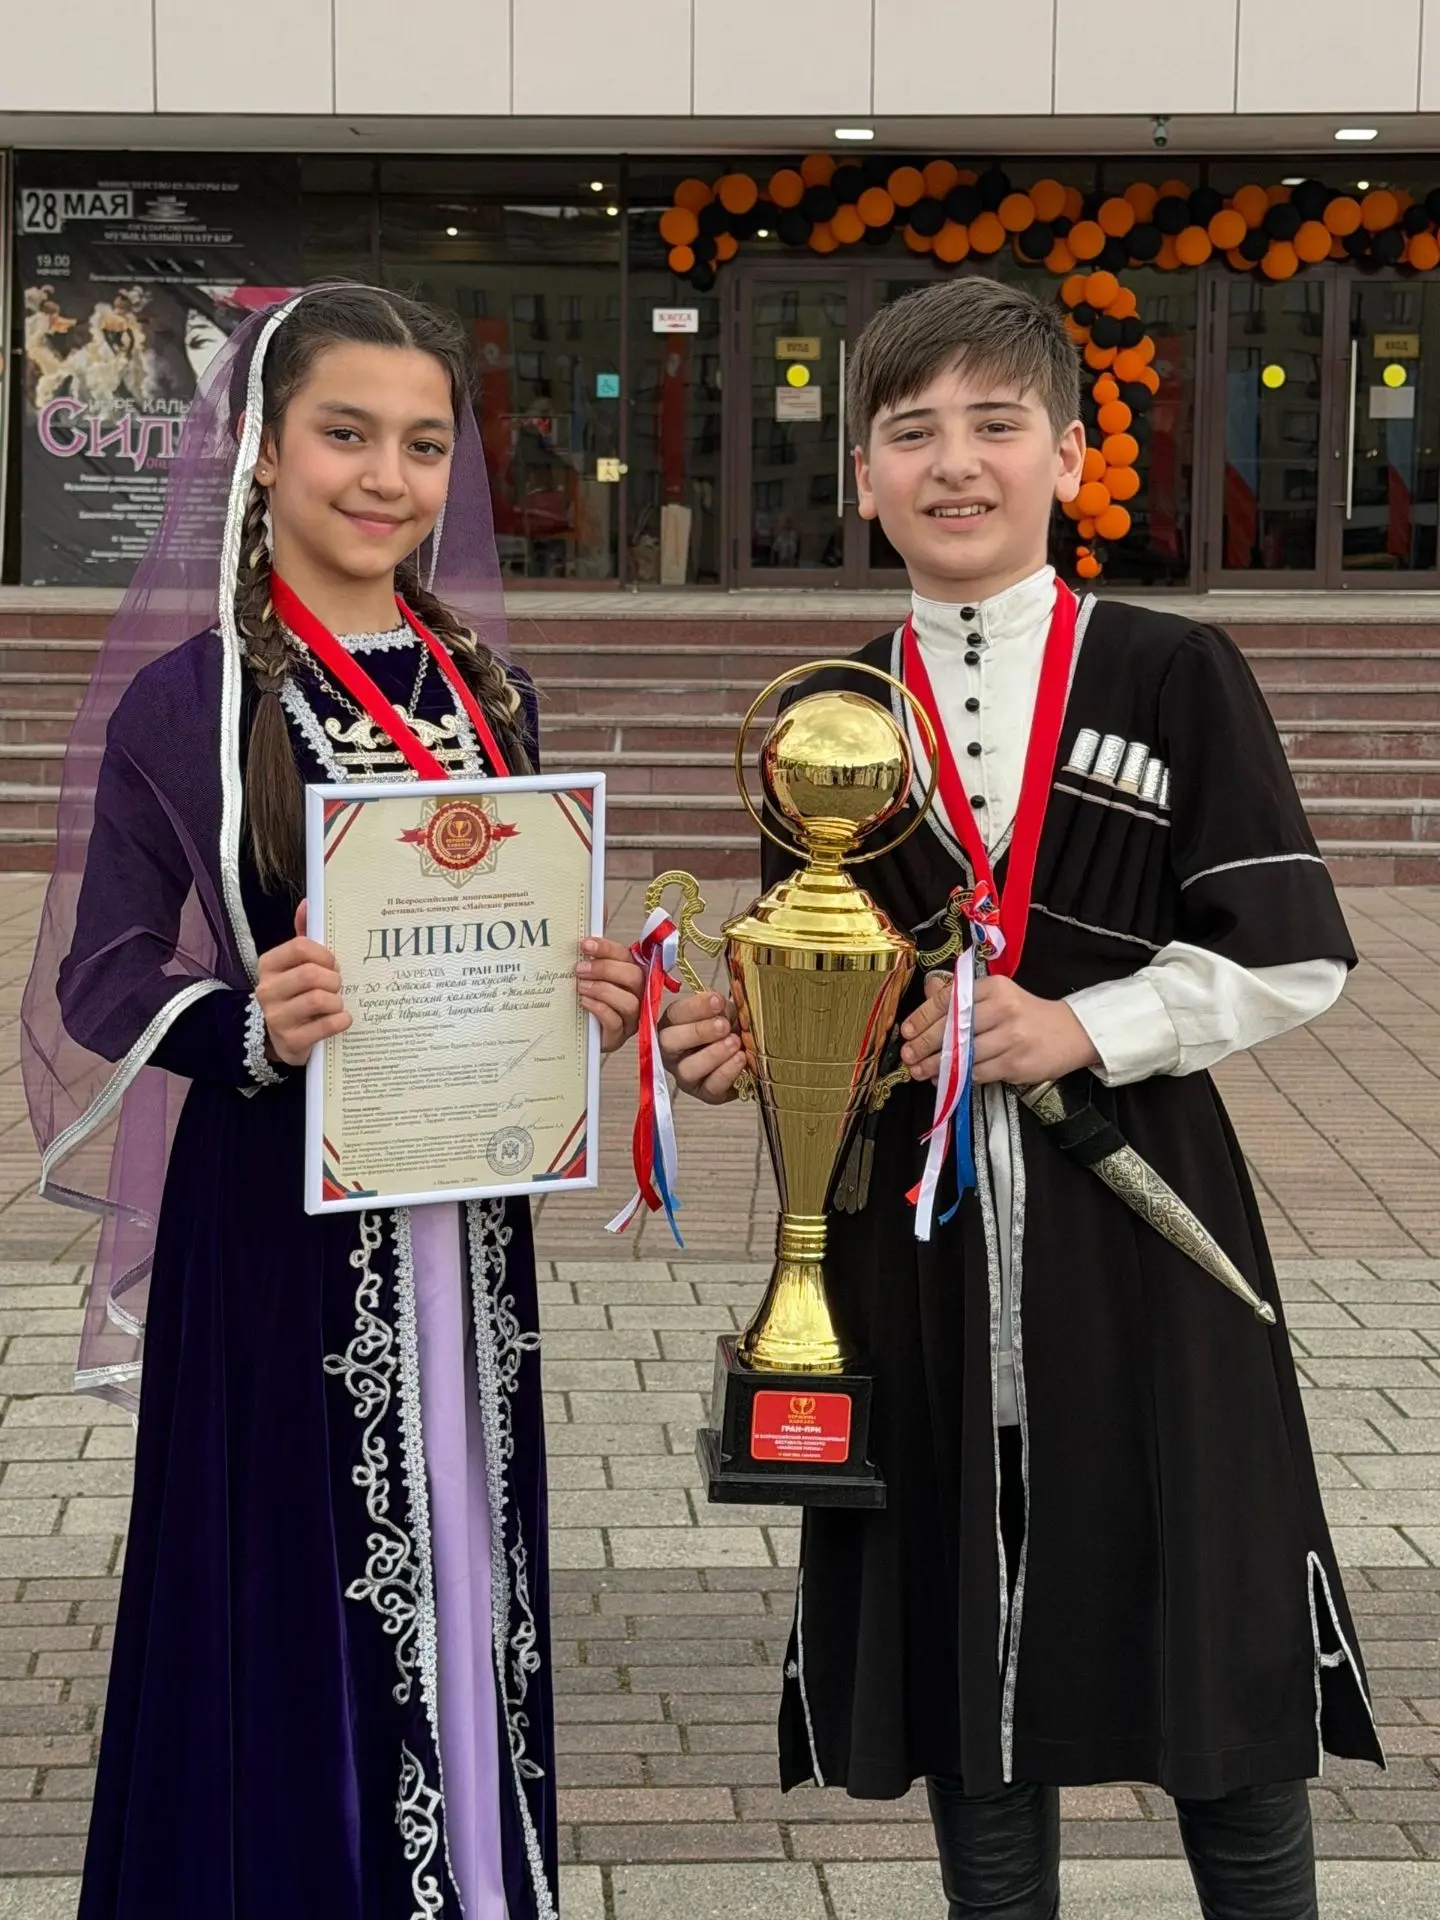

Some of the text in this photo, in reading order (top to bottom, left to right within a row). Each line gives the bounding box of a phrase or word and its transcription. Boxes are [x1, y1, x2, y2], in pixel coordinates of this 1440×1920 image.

[26, 192, 128, 230] 28 МАЯ
[36, 255, 71, 267] 19.00
[395, 895, 459, 906] Всероссийский
[363, 918, 551, 964] ДИПЛОМ
[392, 967, 446, 980] ЛАУРЕАТА
[462, 963, 521, 977] ГРАН ПРИ
[780, 1425, 822, 1433] ГРАН-ПРИ
